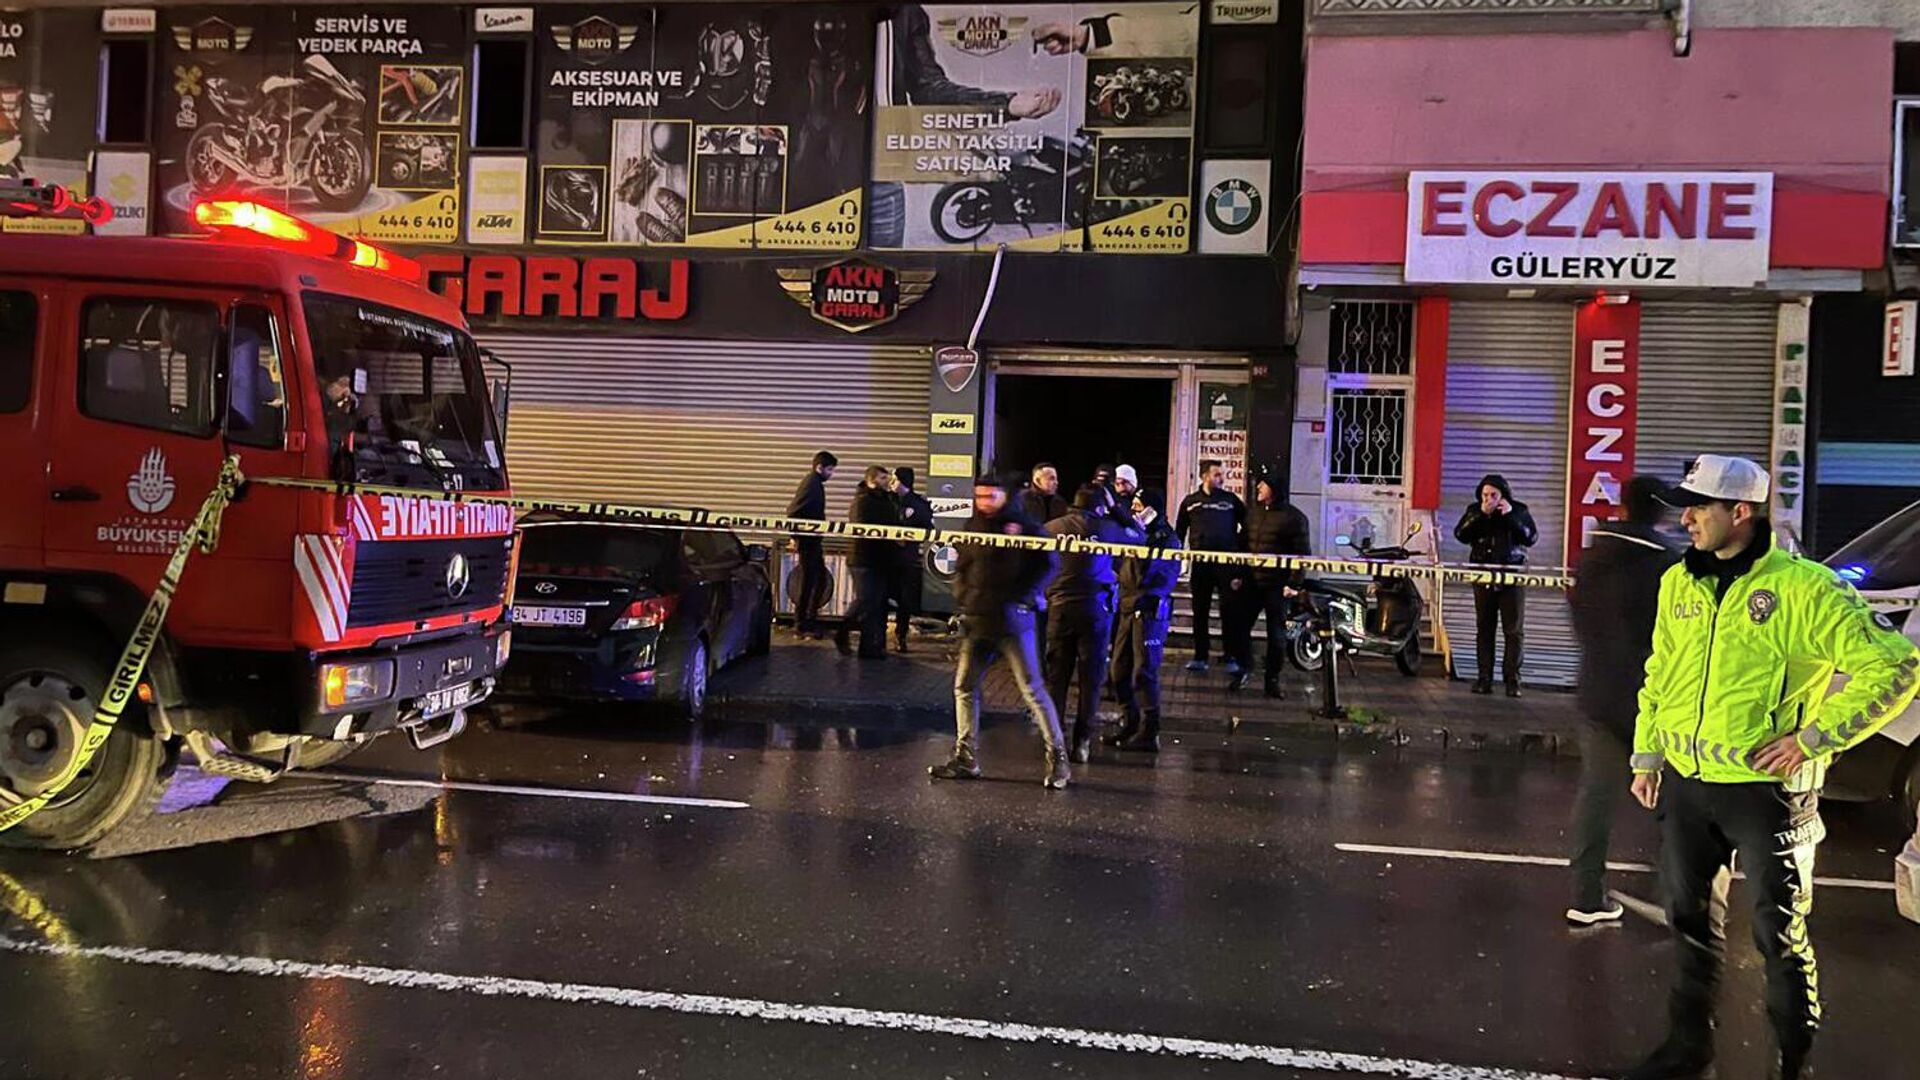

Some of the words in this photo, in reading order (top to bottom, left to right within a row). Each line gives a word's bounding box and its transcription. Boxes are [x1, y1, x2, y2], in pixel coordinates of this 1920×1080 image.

[1216, 5, 1272, 16] TRIUMPH
[315, 14, 380, 33] SERVİS
[383, 19, 408, 33] VE
[965, 17, 1001, 30] AKN
[298, 38, 358, 53] YEDEK
[362, 38, 423, 58] PARÇA
[577, 38, 612, 49] MOTO
[550, 70, 653, 86] AKSESUAR
[656, 71, 683, 86] VE
[572, 87, 659, 106] EKİPMAN
[886, 135, 951, 150] ELDEN
[956, 130, 1044, 150] TAKSİTLİ
[915, 156, 1012, 175] SATIŞLAR
[1211, 180, 1258, 199] BMW
[113, 206, 144, 218] ZUKI
[1421, 180, 1757, 240] ECZANE
[378, 215, 409, 227] 444
[413, 216, 423, 228] 6
[427, 216, 455, 229] 410
[477, 214, 512, 228] KTM
[774, 220, 806, 233] 444
[811, 221, 821, 234] 6
[826, 222, 856, 235] 410
[1102, 225, 1135, 238] 444
[1140, 225, 1151, 238] 6
[1155, 225, 1186, 239] 410
[1491, 252, 1677, 280] GÜLERYÜZ
[825, 266, 884, 288] AKN
[421, 254, 688, 321] GARAJ
[827, 288, 880, 304] MOTO
[821, 303, 886, 318] GARAJ
[939, 419, 966, 429] KTM
[514, 608, 528, 621] 34
[532, 609, 547, 622] JT
[553, 609, 583, 624] 4196
